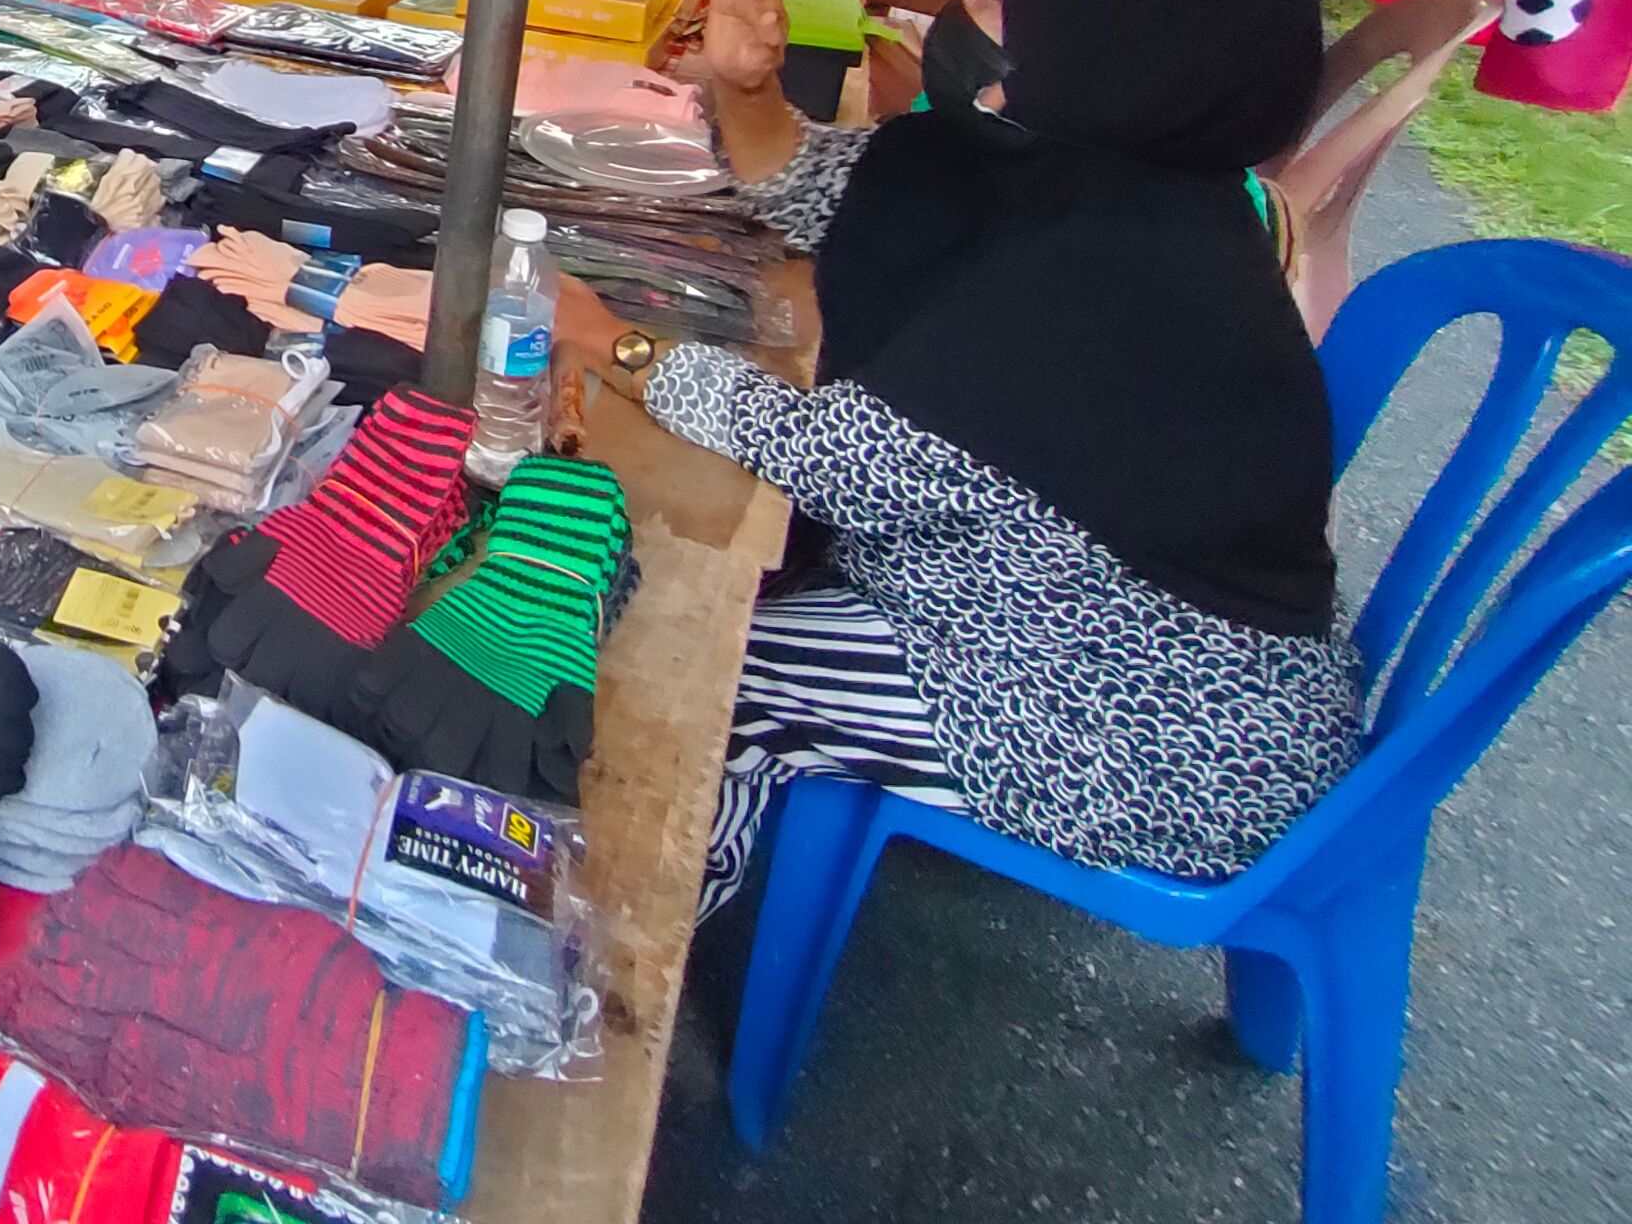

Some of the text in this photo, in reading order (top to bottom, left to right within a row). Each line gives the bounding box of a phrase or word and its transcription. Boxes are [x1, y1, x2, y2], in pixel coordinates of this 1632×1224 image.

[508, 812, 533, 849] OK
[398, 834, 530, 901] HAPPY TIME
